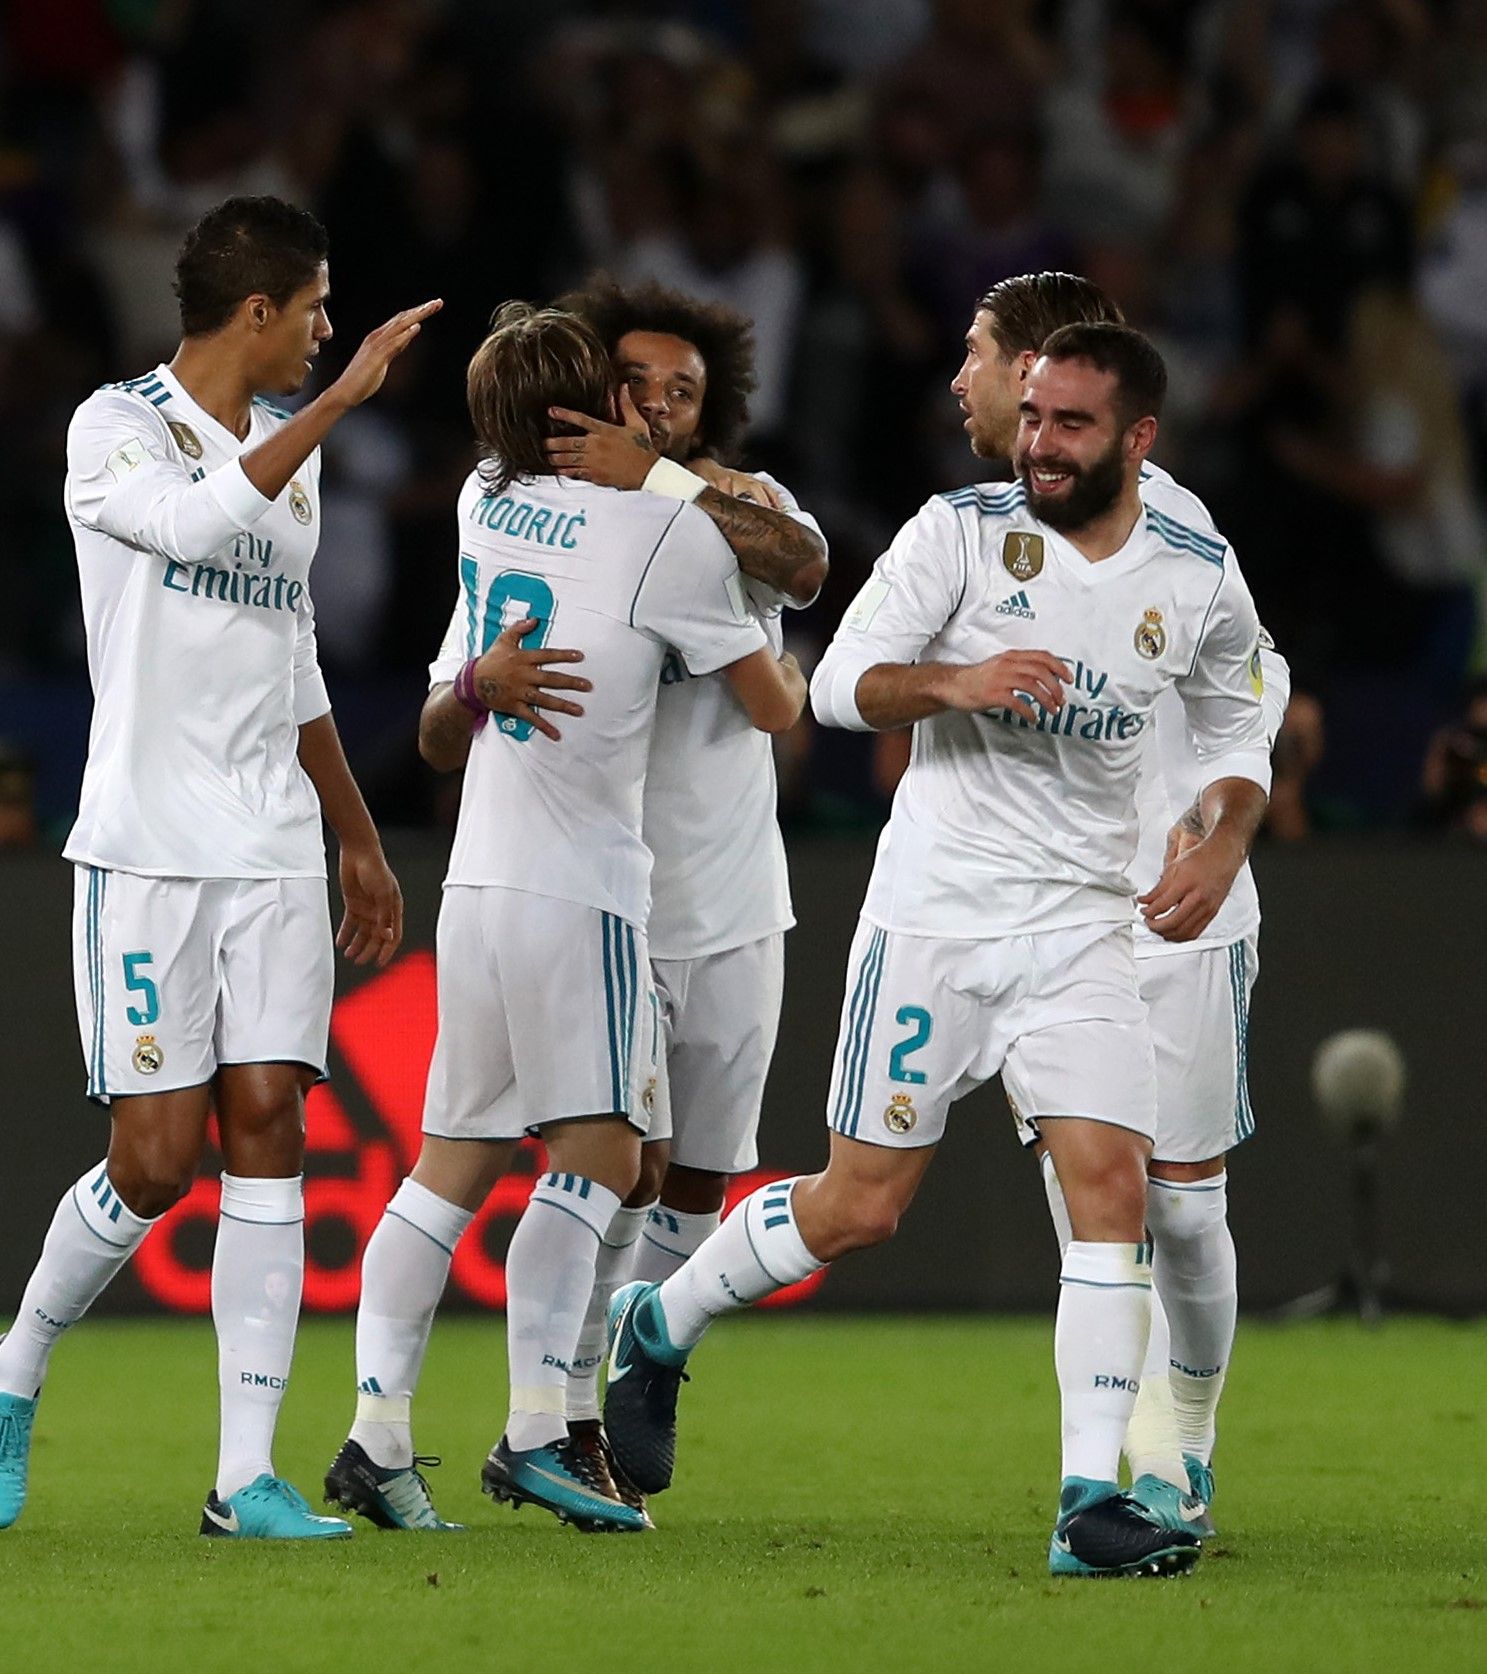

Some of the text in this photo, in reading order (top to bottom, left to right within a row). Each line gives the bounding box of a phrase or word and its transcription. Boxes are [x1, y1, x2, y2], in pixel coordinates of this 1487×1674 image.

[234, 531, 272, 568] Fly
[163, 560, 304, 613] Emirate
[995, 604, 1036, 620] adidas
[1057, 656, 1108, 699] ly
[122, 951, 161, 1026] 5
[888, 1004, 932, 1084] 2
[1094, 1374, 1140, 1395] RMC
